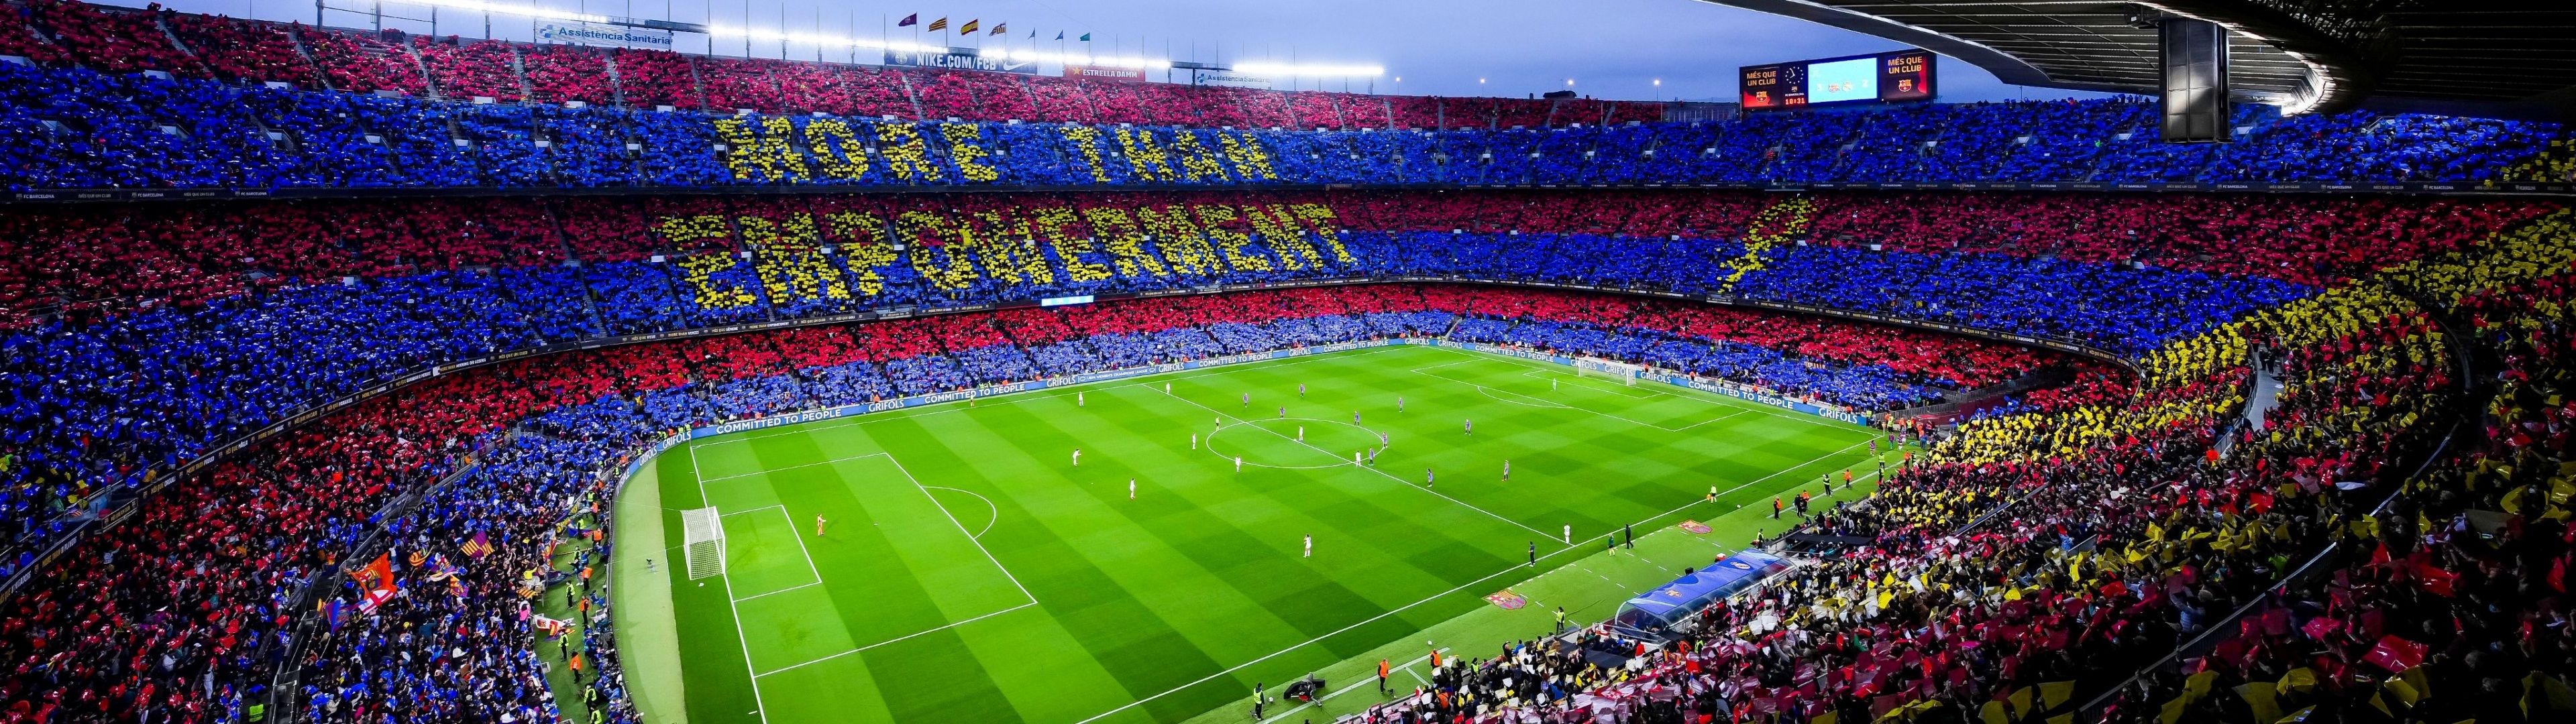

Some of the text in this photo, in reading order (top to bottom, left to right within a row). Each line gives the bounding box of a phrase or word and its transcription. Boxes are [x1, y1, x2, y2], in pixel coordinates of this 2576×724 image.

[559, 27, 671, 45] Assistència Sanitària
[916, 53, 996, 70] NIKE.COM/FCB
[1888, 56, 1923, 66] MÉS QUE
[1083, 69, 1137, 78] ESTRELLA DAMM
[1901, 64, 1921, 72] CLUB
[1747, 70, 1776, 79] MÉS QUE
[1324, 344, 1357, 353] COMMITTED
[1437, 340, 1463, 349] GRIFOLS
[1289, 348, 1311, 357] GRIFOLS
[1474, 345, 1515, 355] COMMITTED
[1527, 353, 1554, 363] PEOPLE
[1199, 357, 1237, 367] COMMITTED
[1249, 353, 1273, 361] PEOPLE
[1570, 359, 1597, 370] GRFOLS
[1158, 363, 1185, 373] GRIFOLS
[1605, 365, 1633, 376] GRIFOS
[1046, 376, 1076, 387] GRIFOLS
[1640, 371, 1671, 383] GRIFOLS
[924, 390, 977, 404] COMMITTED
[994, 383, 1025, 394] PEOPLE
[1688, 381, 1793, 409] COMMITTED TO PEOPLE
[339, 398, 353, 406] PARAULES
[868, 400, 904, 412] GRIFOLS
[716, 409, 841, 434] COMMITTED TO PEOPLE
[1818, 408, 1858, 424] GRIFOLS
[663, 431, 691, 449] GRIFOLS
[639, 445, 657, 467] GRIFOLS
[186, 456, 215, 474] MORE THAN PROUD
[164, 476, 176, 488] ORGULL
[42, 555, 52, 568] MORE
[52, 548, 61, 560] THAN
[64, 536, 77, 552] PLAYERS
